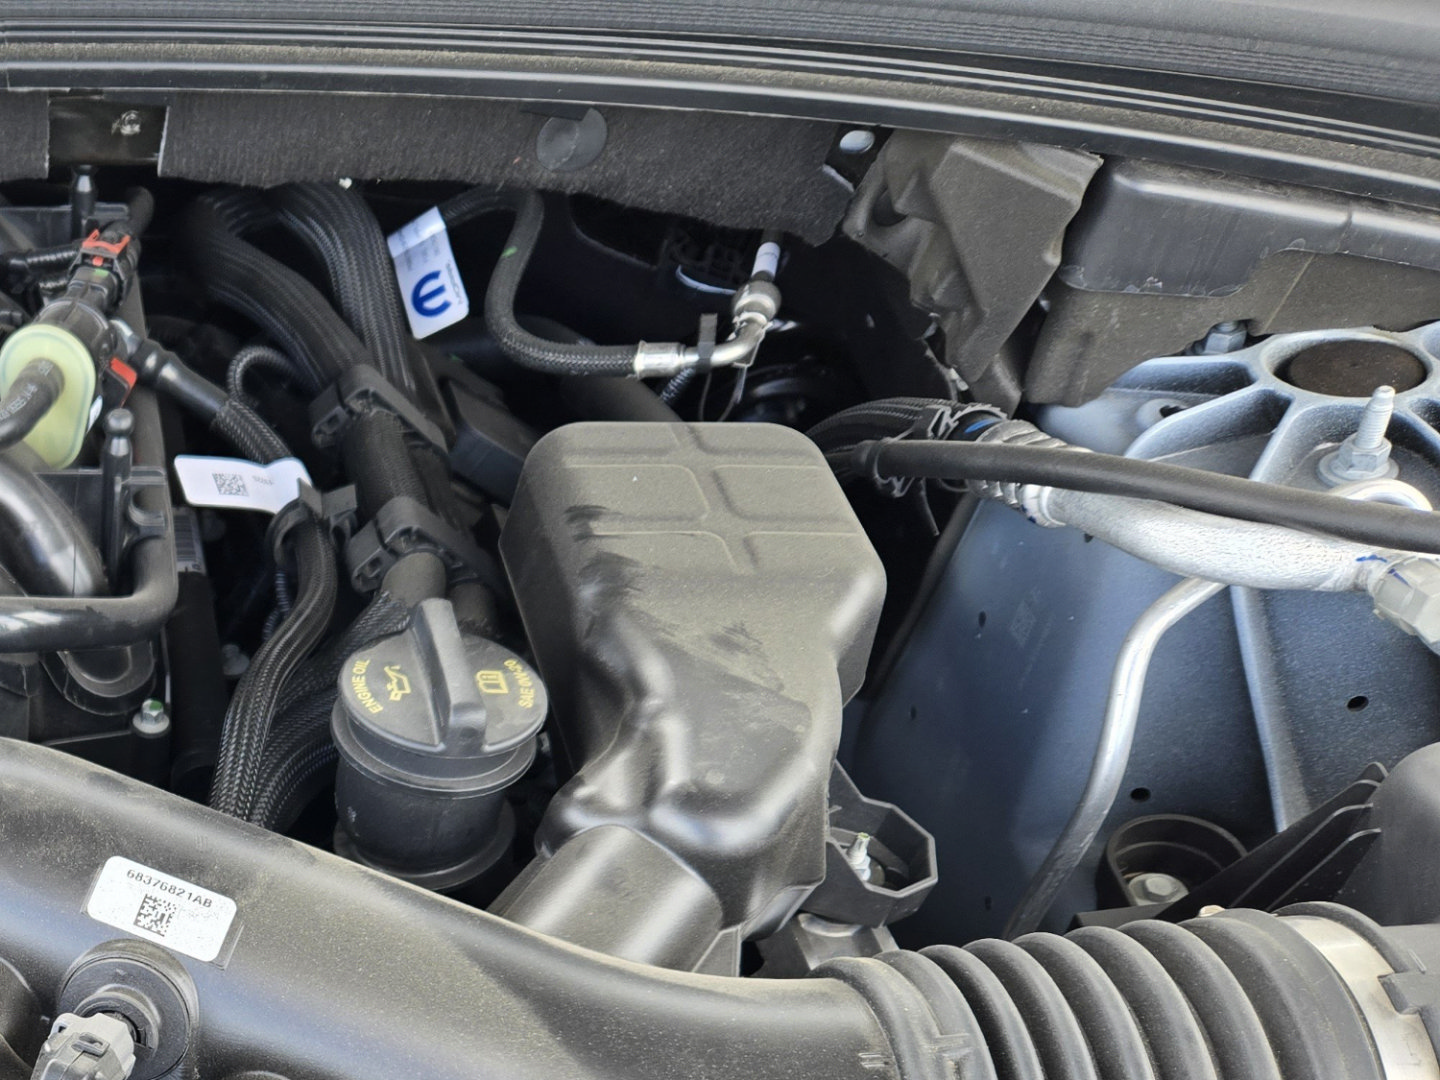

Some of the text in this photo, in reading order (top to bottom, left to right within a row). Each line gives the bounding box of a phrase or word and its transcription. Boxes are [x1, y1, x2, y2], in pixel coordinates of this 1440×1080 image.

[351, 658, 384, 714] ENGINE OIL
[518, 687, 536, 709] SAE
[126, 868, 213, 909] 68376821AB
